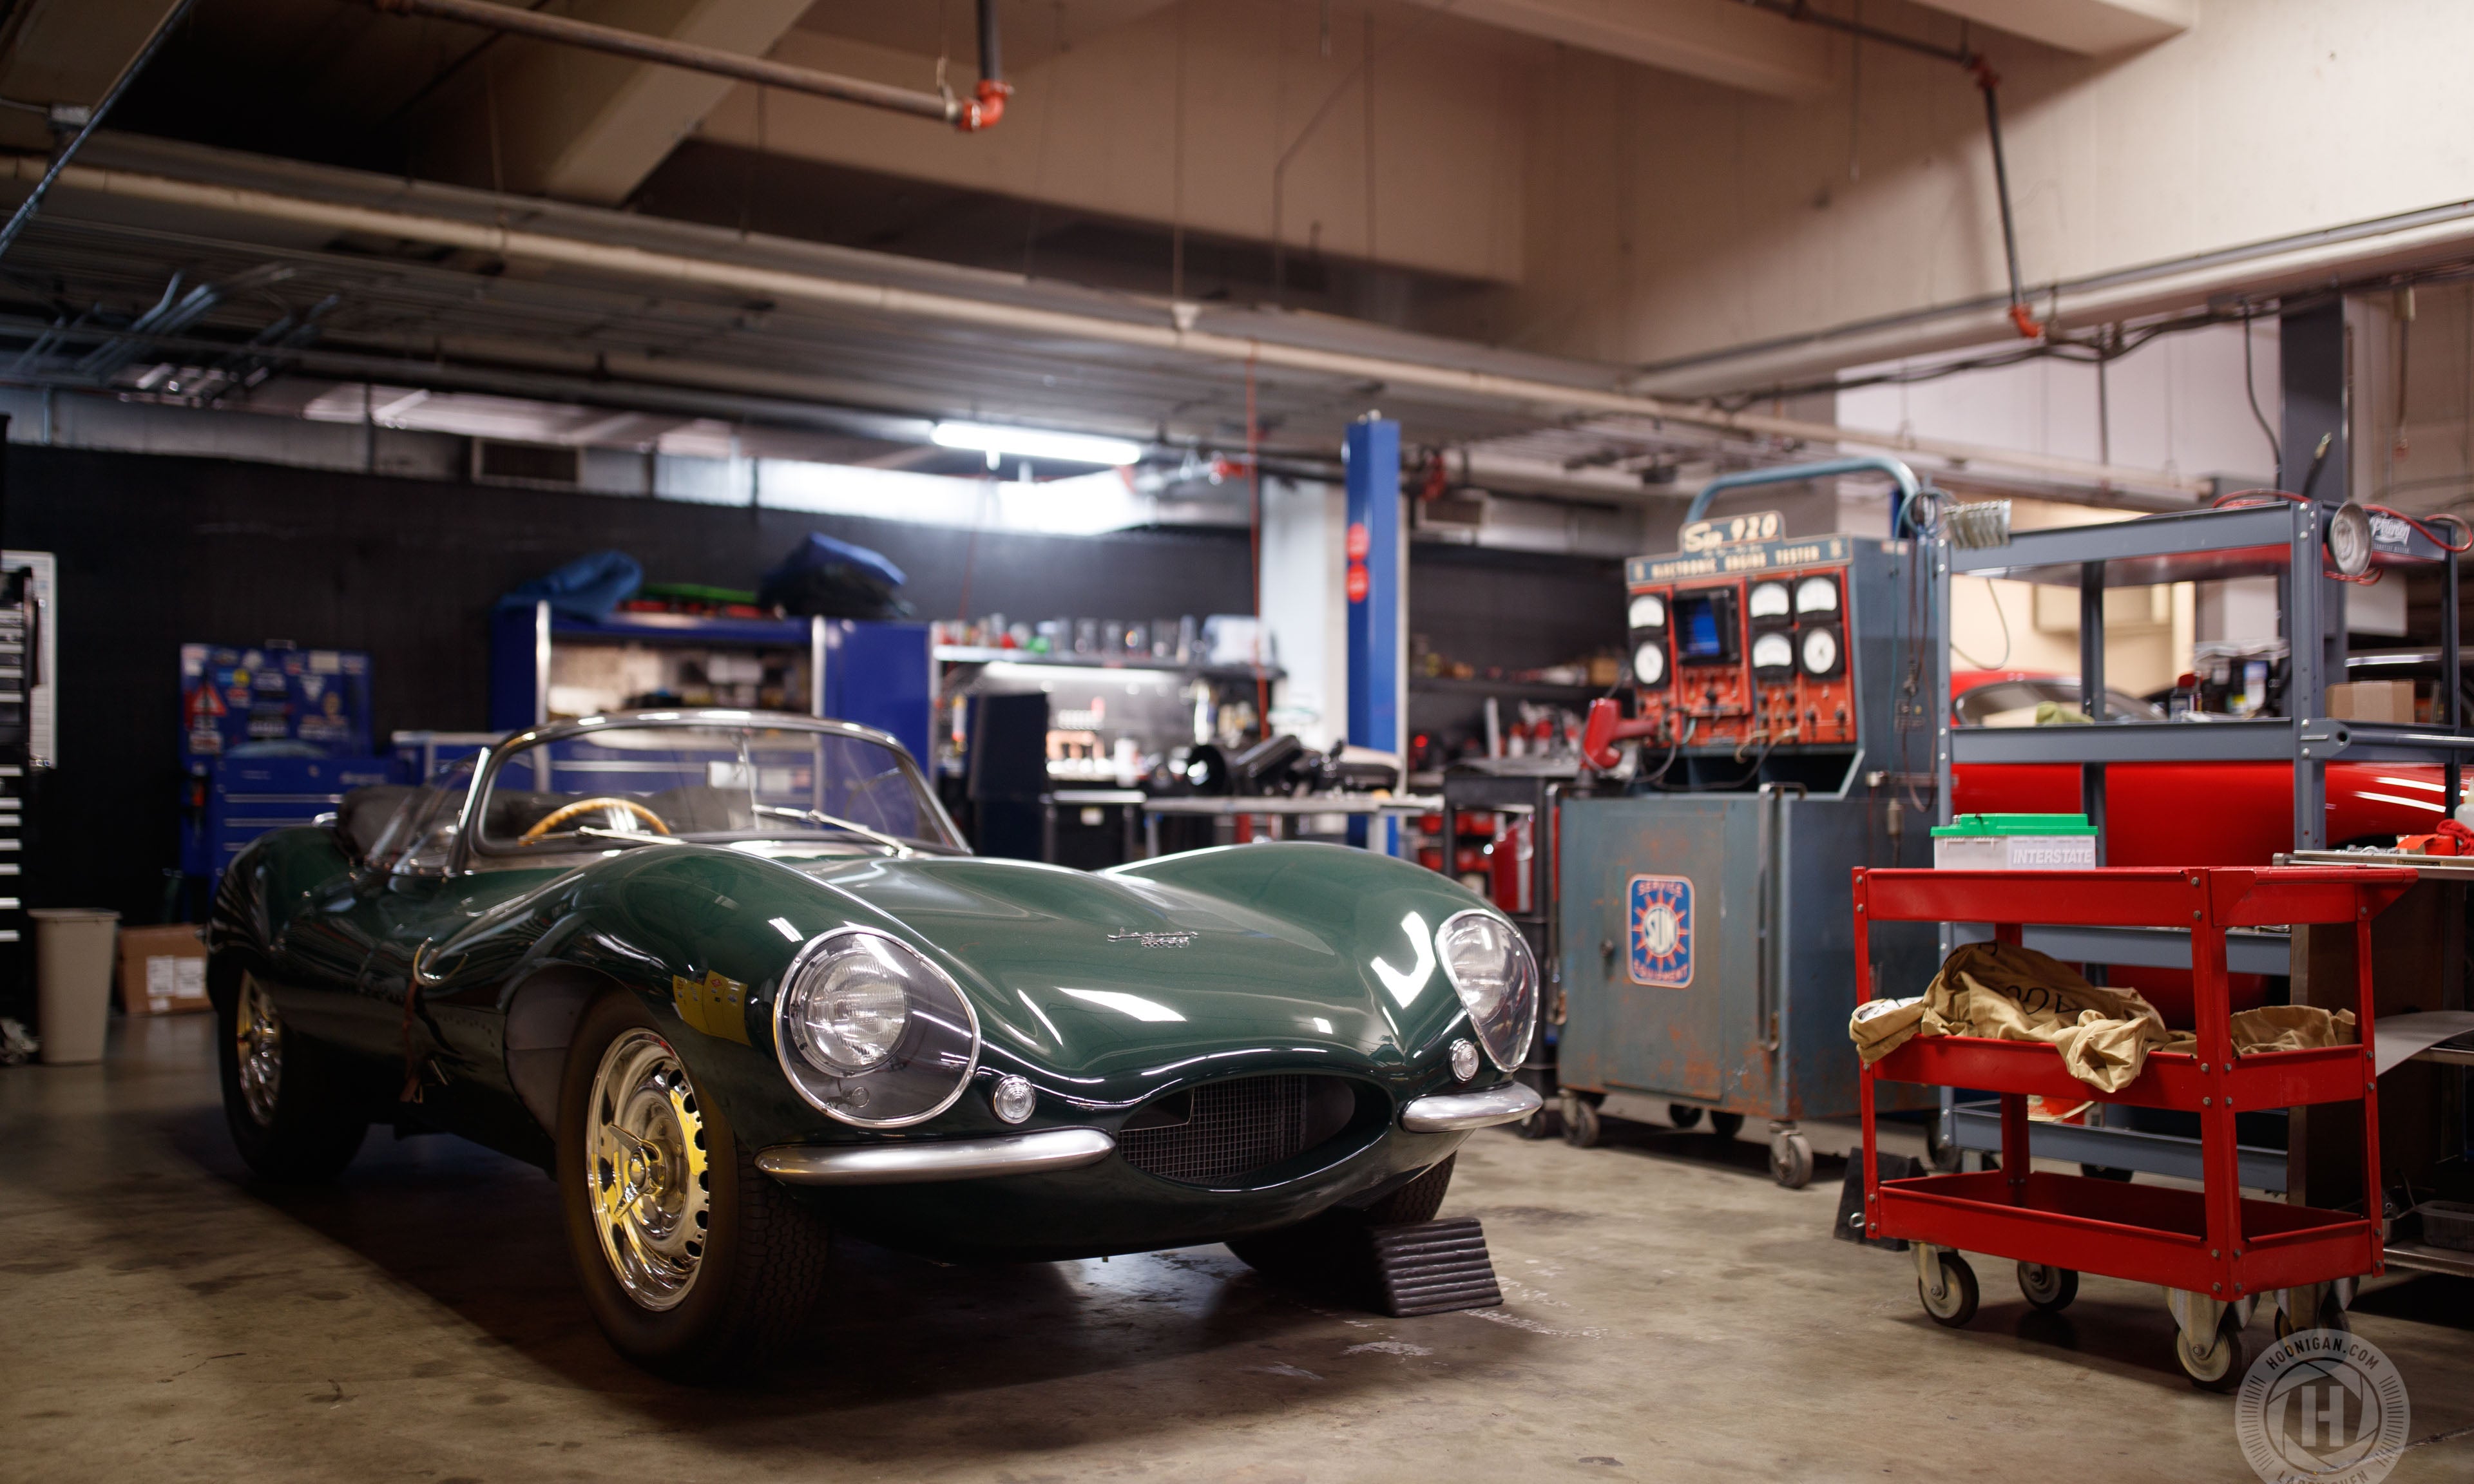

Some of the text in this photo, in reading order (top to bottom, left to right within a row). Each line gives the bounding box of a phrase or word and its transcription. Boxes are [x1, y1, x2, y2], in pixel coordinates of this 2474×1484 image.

[1731, 513, 1778, 542] 920
[1776, 545, 1820, 566] TESTER
[2013, 848, 2093, 864] INTERSTATE
[1637, 881, 1683, 897] SERVICE
[1645, 908, 1678, 955] SUN
